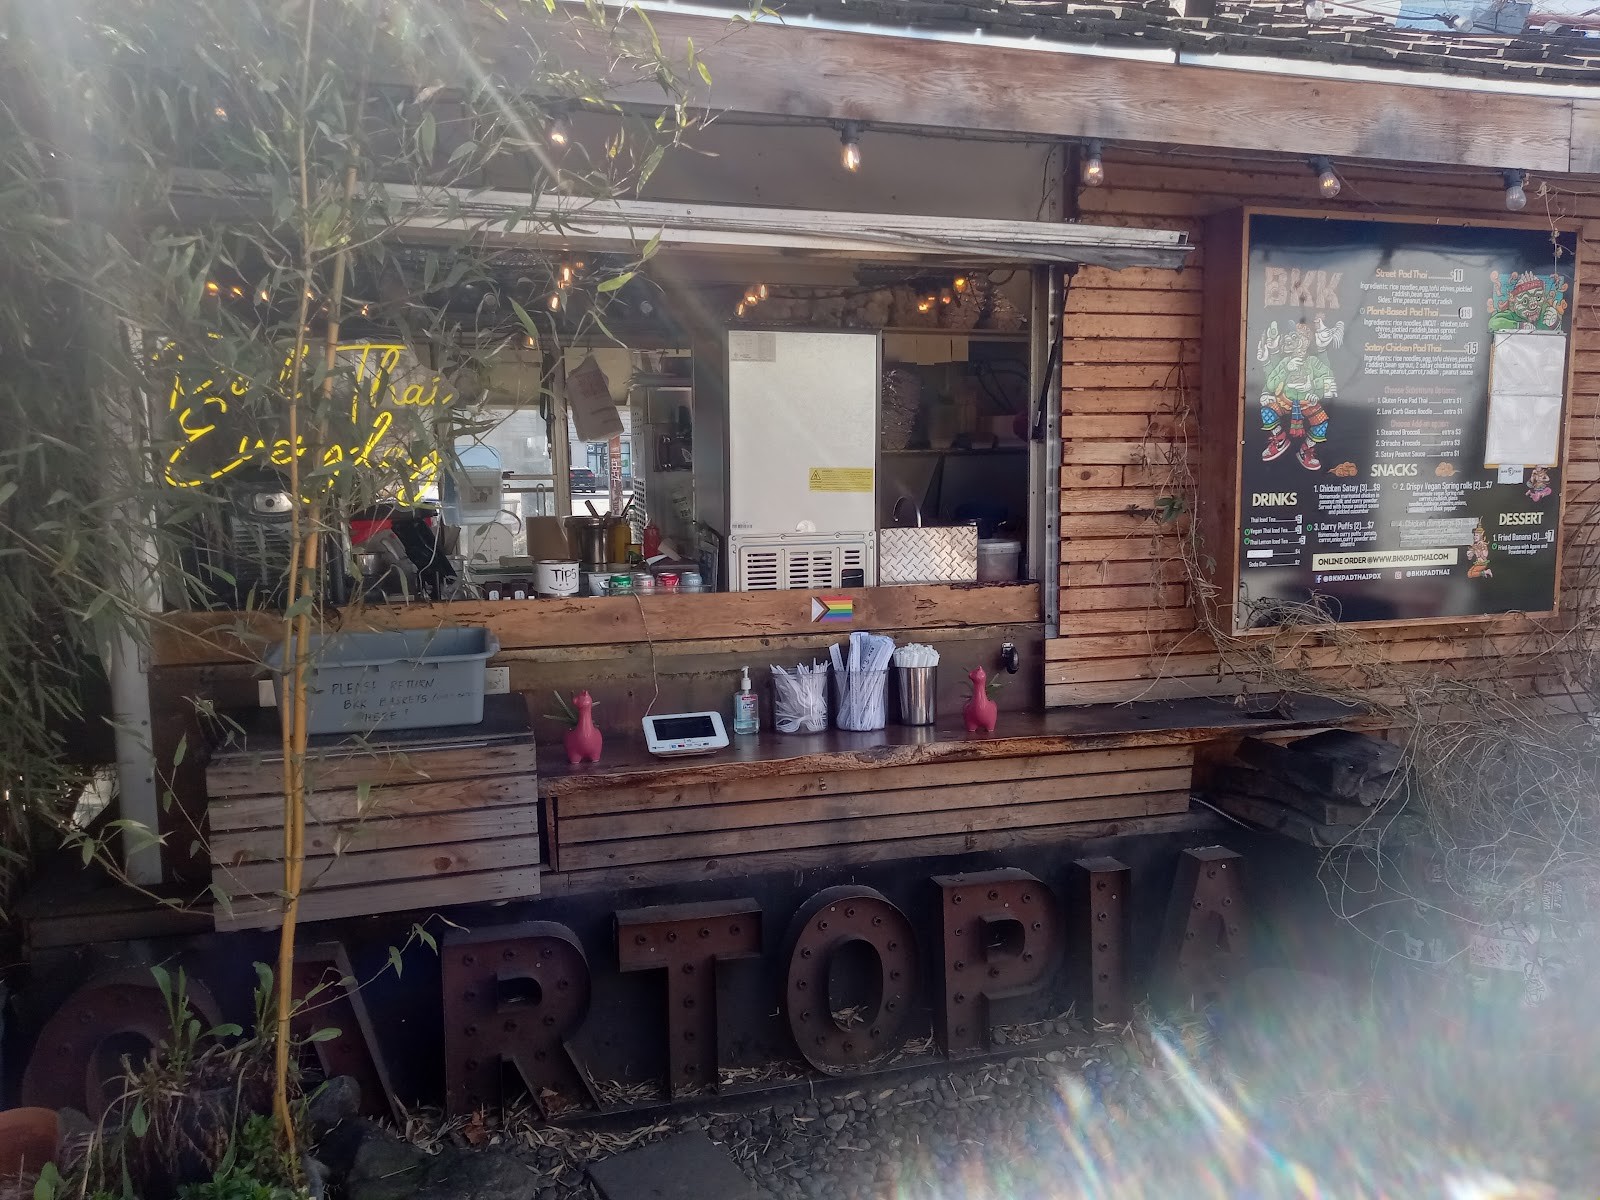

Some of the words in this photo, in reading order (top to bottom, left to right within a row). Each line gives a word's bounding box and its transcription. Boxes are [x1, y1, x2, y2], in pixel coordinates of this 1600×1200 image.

[1375, 268, 1396, 278] Street
[1398, 270, 1412, 278] Pad
[1412, 270, 1428, 279] Thai
[1264, 267, 1343, 309] BKK
[1366, 306, 1408, 316] Plant-Based
[1409, 307, 1423, 316] Pad
[1424, 308, 1439, 317] Thai
[1364, 342, 1385, 353] Satay
[1386, 343, 1412, 352] Chicken
[1413, 344, 1426, 352] Pad
[1427, 344, 1442, 353] Thai
[1370, 463, 1418, 477] SNACKS
[1320, 484, 1342, 492] Chicken
[1342, 484, 1358, 494] Satay
[1374, 483, 1380, 492] $9
[1400, 483, 1406, 491] 2.
[1406, 483, 1424, 492] Crispy
[1424, 482, 1442, 492] Vegan
[1442, 482, 1460, 491] Spring
[1460, 482, 1472, 490] rolls
[1486, 481, 1492, 489] $7
[1252, 492, 1298, 506] DRINKS
[1498, 512, 1544, 526] DESSERT
[1314, 523, 1320, 531] 3.
[1320, 522, 1336, 532] Curry
[1338, 521, 1353, 530] Puffs
[1368, 520, 1374, 530] $7
[1492, 534, 1498, 542] 1.
[1498, 533, 1512, 542] Fried
[1512, 532, 1532, 541] Banana
[1318, 558, 1343, 566] ONLINE
[1344, 556, 1366, 564] ORDER
[1323, 573, 1382, 582] @BKKPADTHAIPDX
[1406, 568, 1450, 578] @BKKPADTHAI
